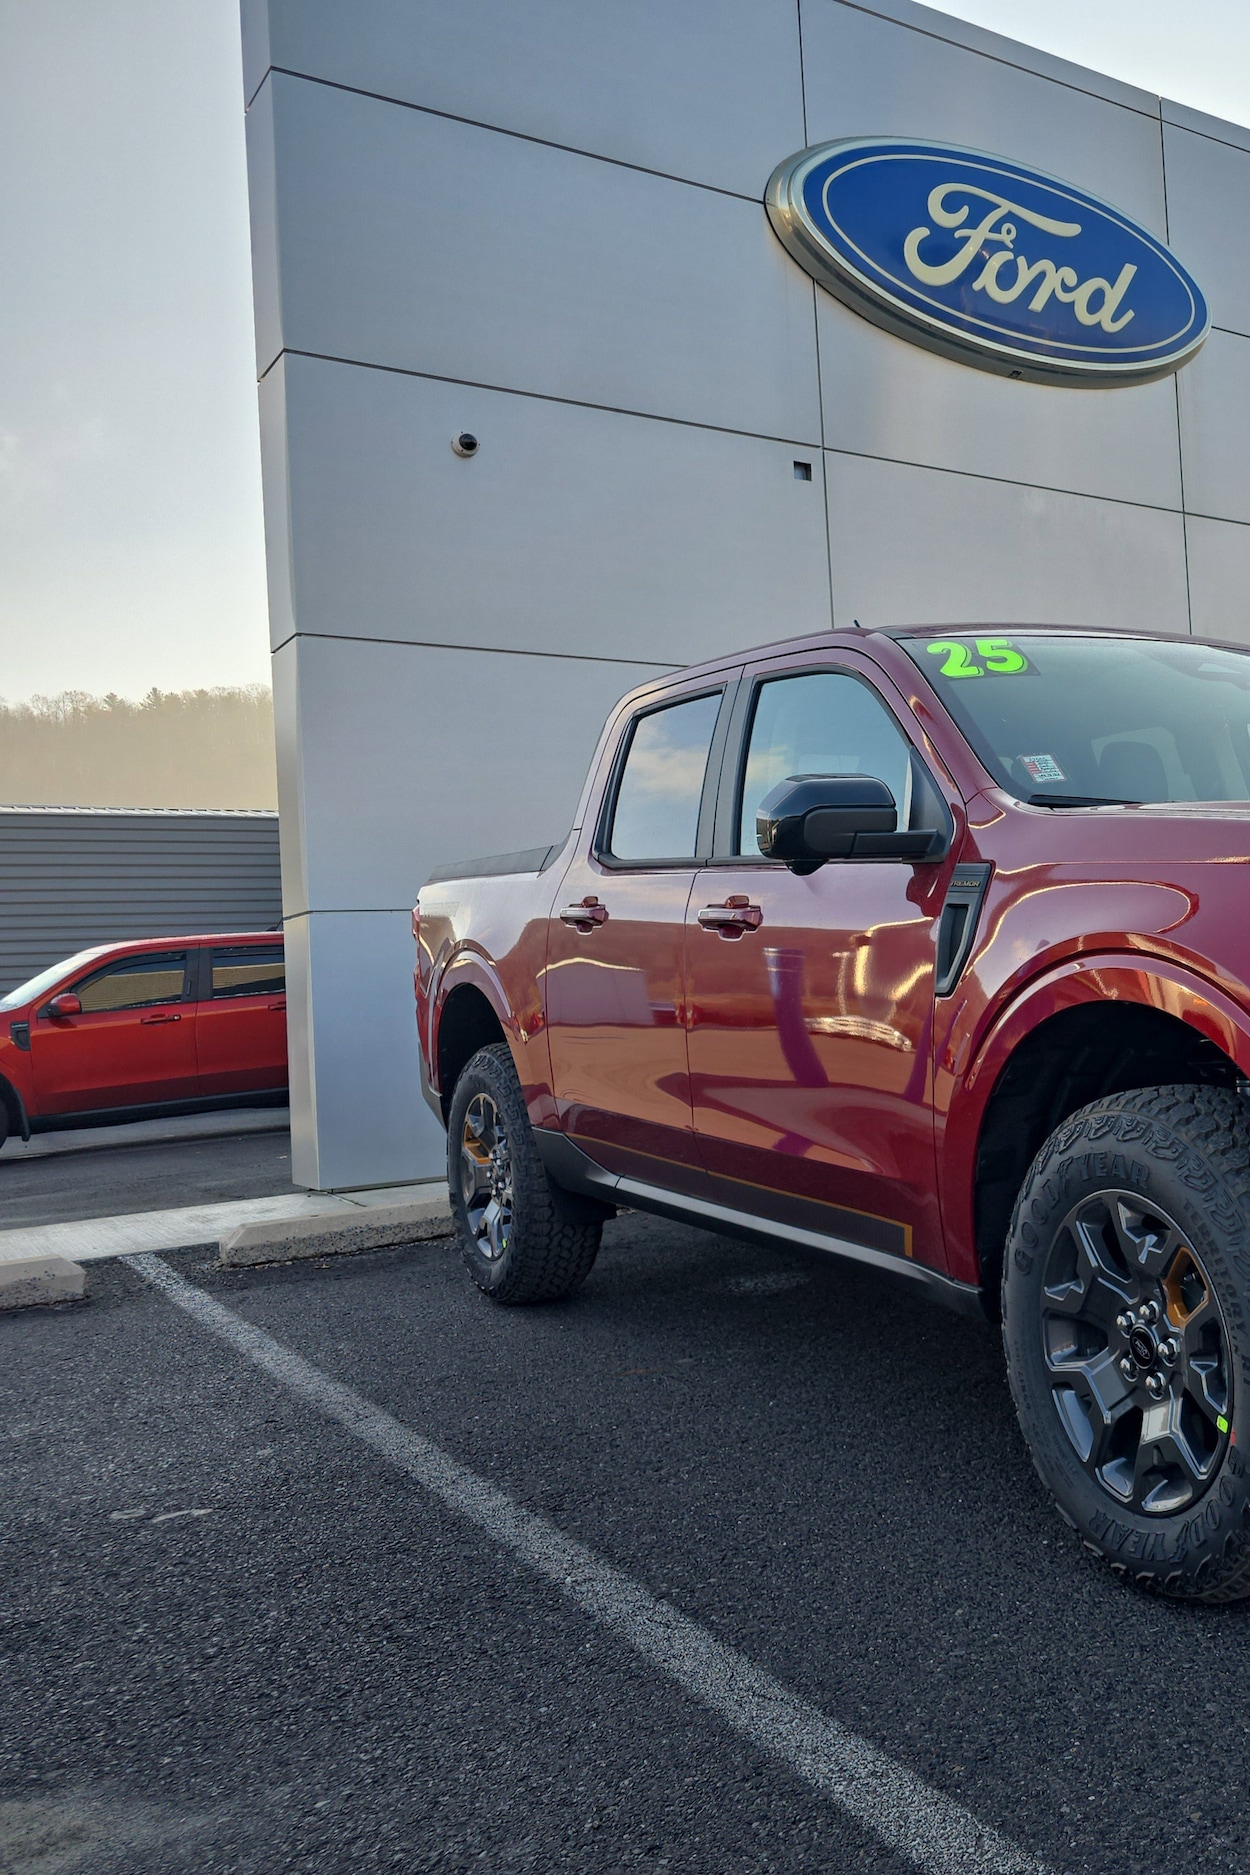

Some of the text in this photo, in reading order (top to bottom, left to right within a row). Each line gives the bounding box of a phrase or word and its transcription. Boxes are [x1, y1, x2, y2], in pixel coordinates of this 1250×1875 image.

[904, 183, 1138, 333] Ford
[926, 639, 1029, 678] 25
[1014, 1150, 1152, 1277] GOODYEAR
